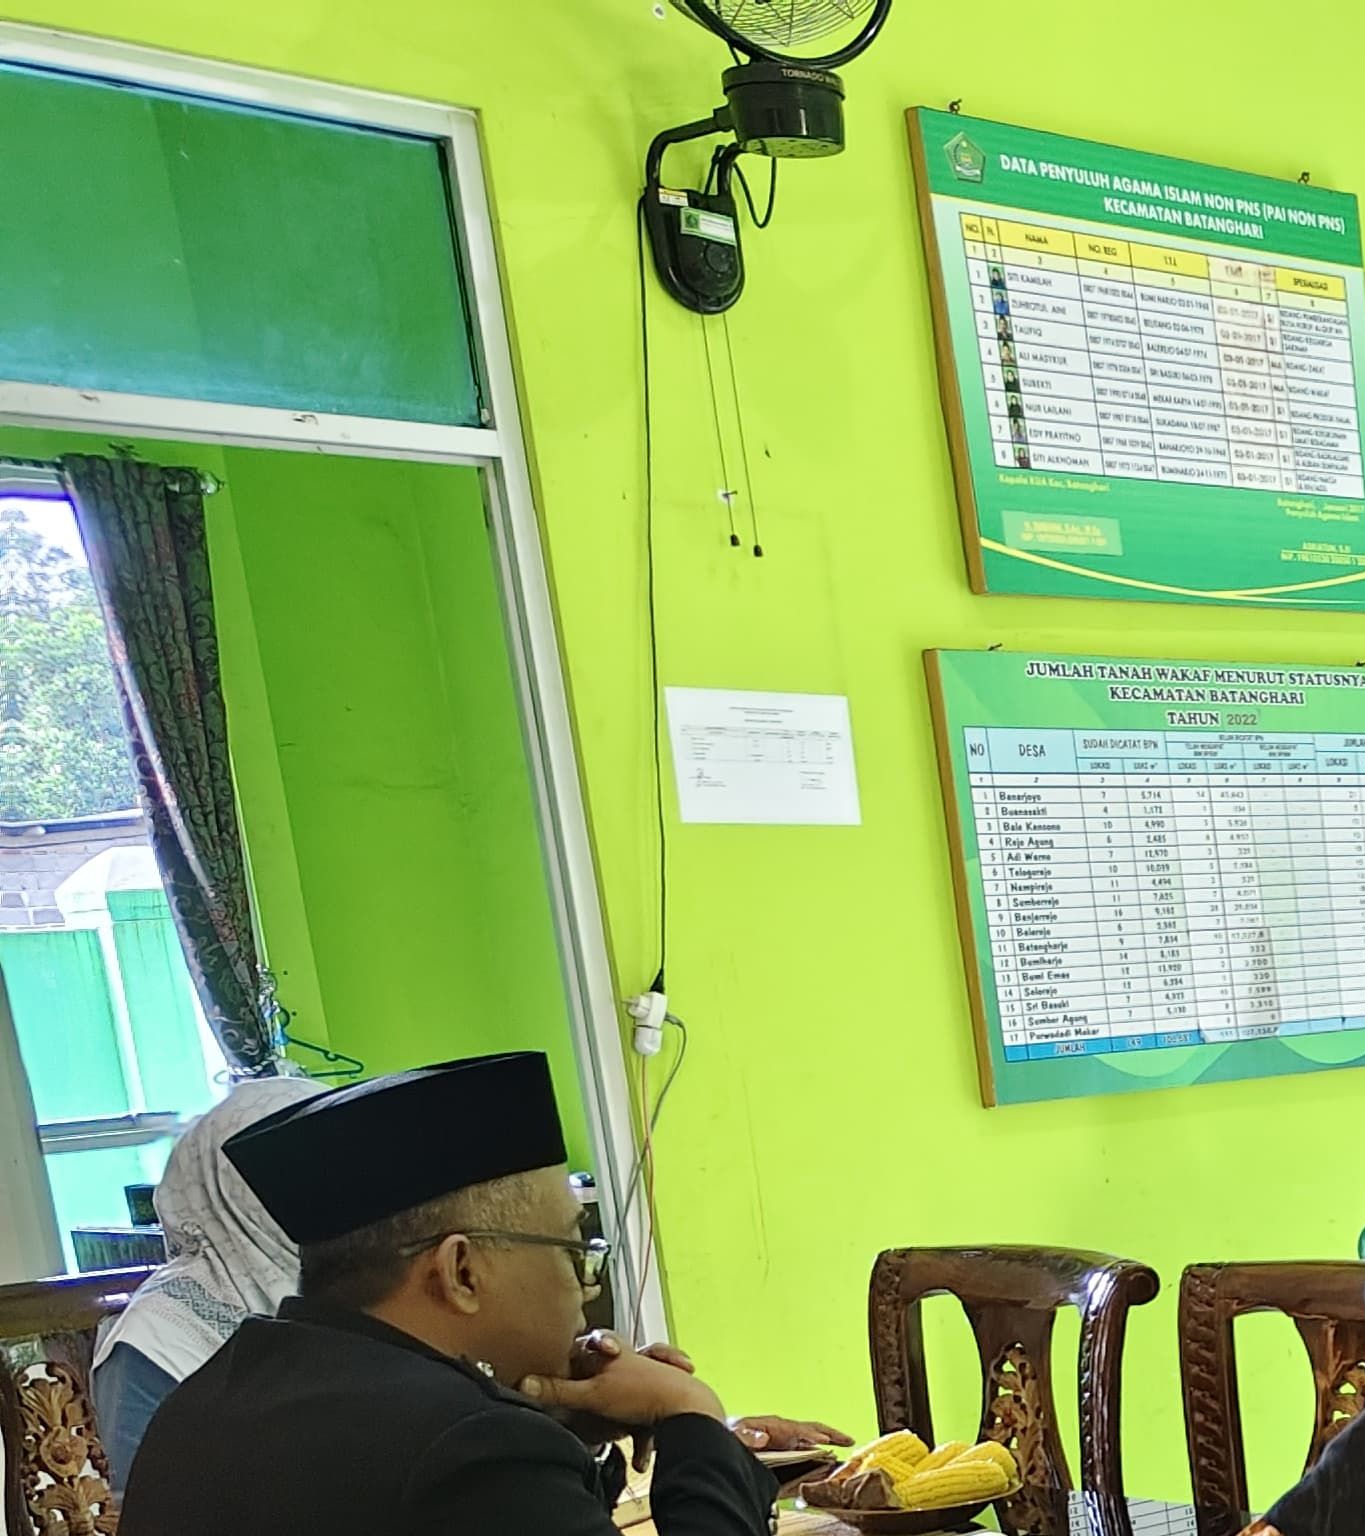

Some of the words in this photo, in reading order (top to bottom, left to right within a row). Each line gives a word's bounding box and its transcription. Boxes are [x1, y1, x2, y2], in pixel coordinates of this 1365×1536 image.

[782, 69, 824, 82] TORNADO
[1000, 154, 1038, 176] DATA
[1039, 161, 1110, 190] PENYULUH
[1113, 175, 1162, 199] AGAMA
[1164, 185, 1202, 203] ISLAM
[1204, 193, 1234, 213] NON
[1236, 200, 1261, 218] PNS
[1263, 203, 1287, 222] (PAI
[1287, 208, 1317, 228] NON
[1318, 215, 1346, 235] PNS)
[1104, 197, 1183, 225] KECAMATAN
[1184, 211, 1264, 240] BATANGHARI
[1025, 234, 1049, 245] NAMA
[1025, 402, 1042, 414] NUR
[1027, 662, 1094, 678] JUMLAH
[1097, 665, 1152, 680] TANAH
[1156, 667, 1211, 682] WAKAF
[1215, 670, 1285, 685] MENURUT
[1110, 686, 1206, 701] KECAMATAN
[1210, 689, 1305, 705] BATANGHARI
[1167, 711, 1219, 725] TAHUN
[1226, 713, 1258, 726] 2022
[969, 743, 985, 756] NO
[1019, 744, 1046, 757] DESA
[1083, 738, 1109, 749] SUDAH
[999, 792, 1041, 803] Banarjoyo
[996, 929, 1006, 938] 10
[1026, 1002, 1038, 1011] Sri
